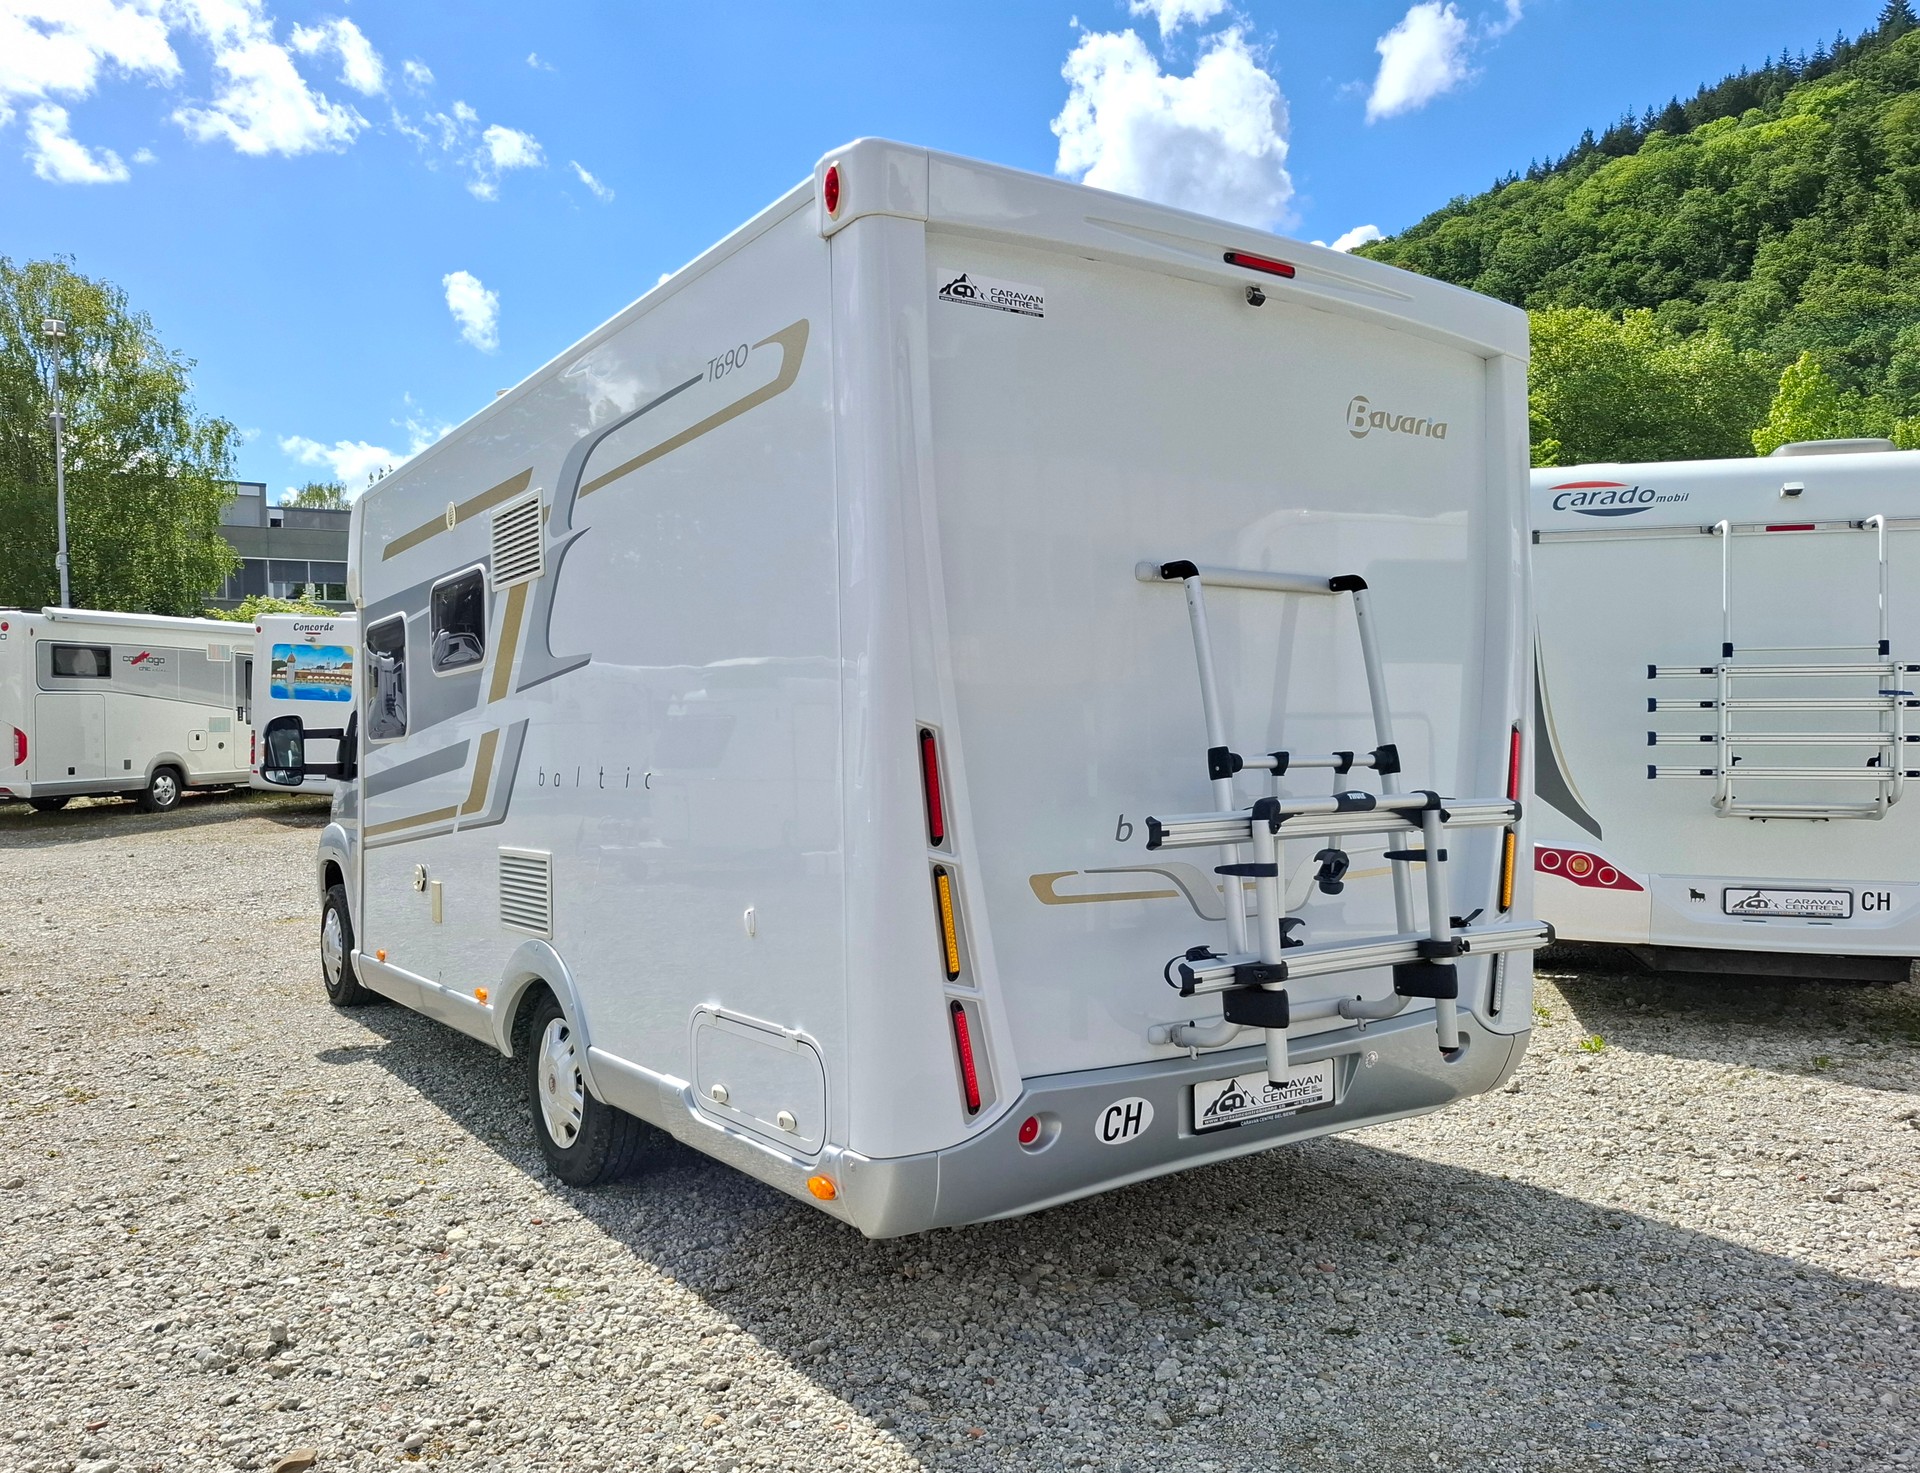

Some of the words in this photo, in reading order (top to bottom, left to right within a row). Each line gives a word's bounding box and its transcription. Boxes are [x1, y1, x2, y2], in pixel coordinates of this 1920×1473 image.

[990, 287, 1044, 304] CARAVAN
[990, 295, 1033, 310] CENTRE
[707, 343, 749, 383] T690
[1346, 395, 1448, 440] Bavaria
[1552, 485, 1656, 511] carado
[1655, 492, 1690, 503] mobil
[293, 622, 335, 631] Concorde
[122, 655, 166, 666] caago
[1785, 898, 1844, 906] CARAVAN
[1861, 891, 1891, 912] CH
[1262, 1074, 1323, 1093] CAVAN
[1262, 1086, 1311, 1104] CENTRE
[1102, 1101, 1143, 1143] CH
[1240, 1118, 1260, 1127] CARAVAN
